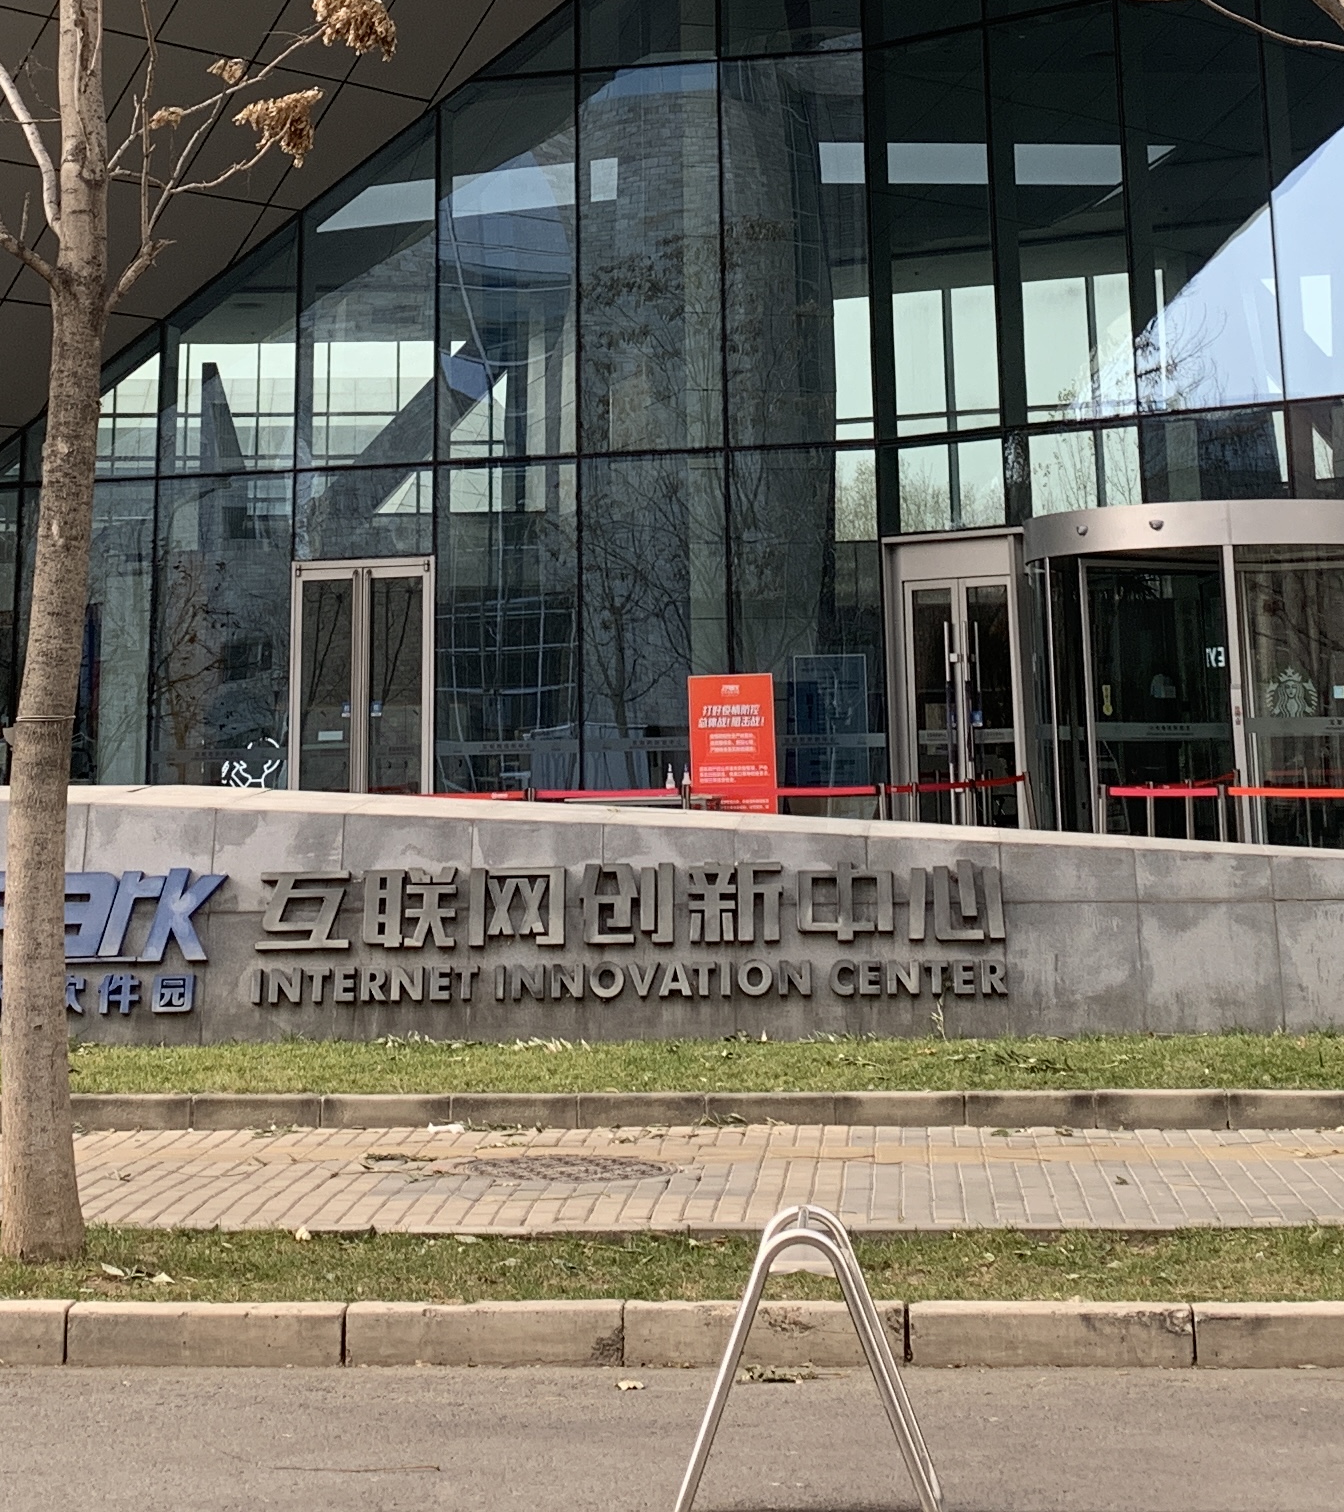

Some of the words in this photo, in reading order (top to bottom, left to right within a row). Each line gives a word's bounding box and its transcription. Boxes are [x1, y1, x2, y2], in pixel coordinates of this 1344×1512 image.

[256, 861, 1006, 949] 互联网创新中心
[252, 964, 479, 1004] INTERNET
[496, 960, 812, 1000] INNOVATION
[830, 959, 1008, 998] CENTER
